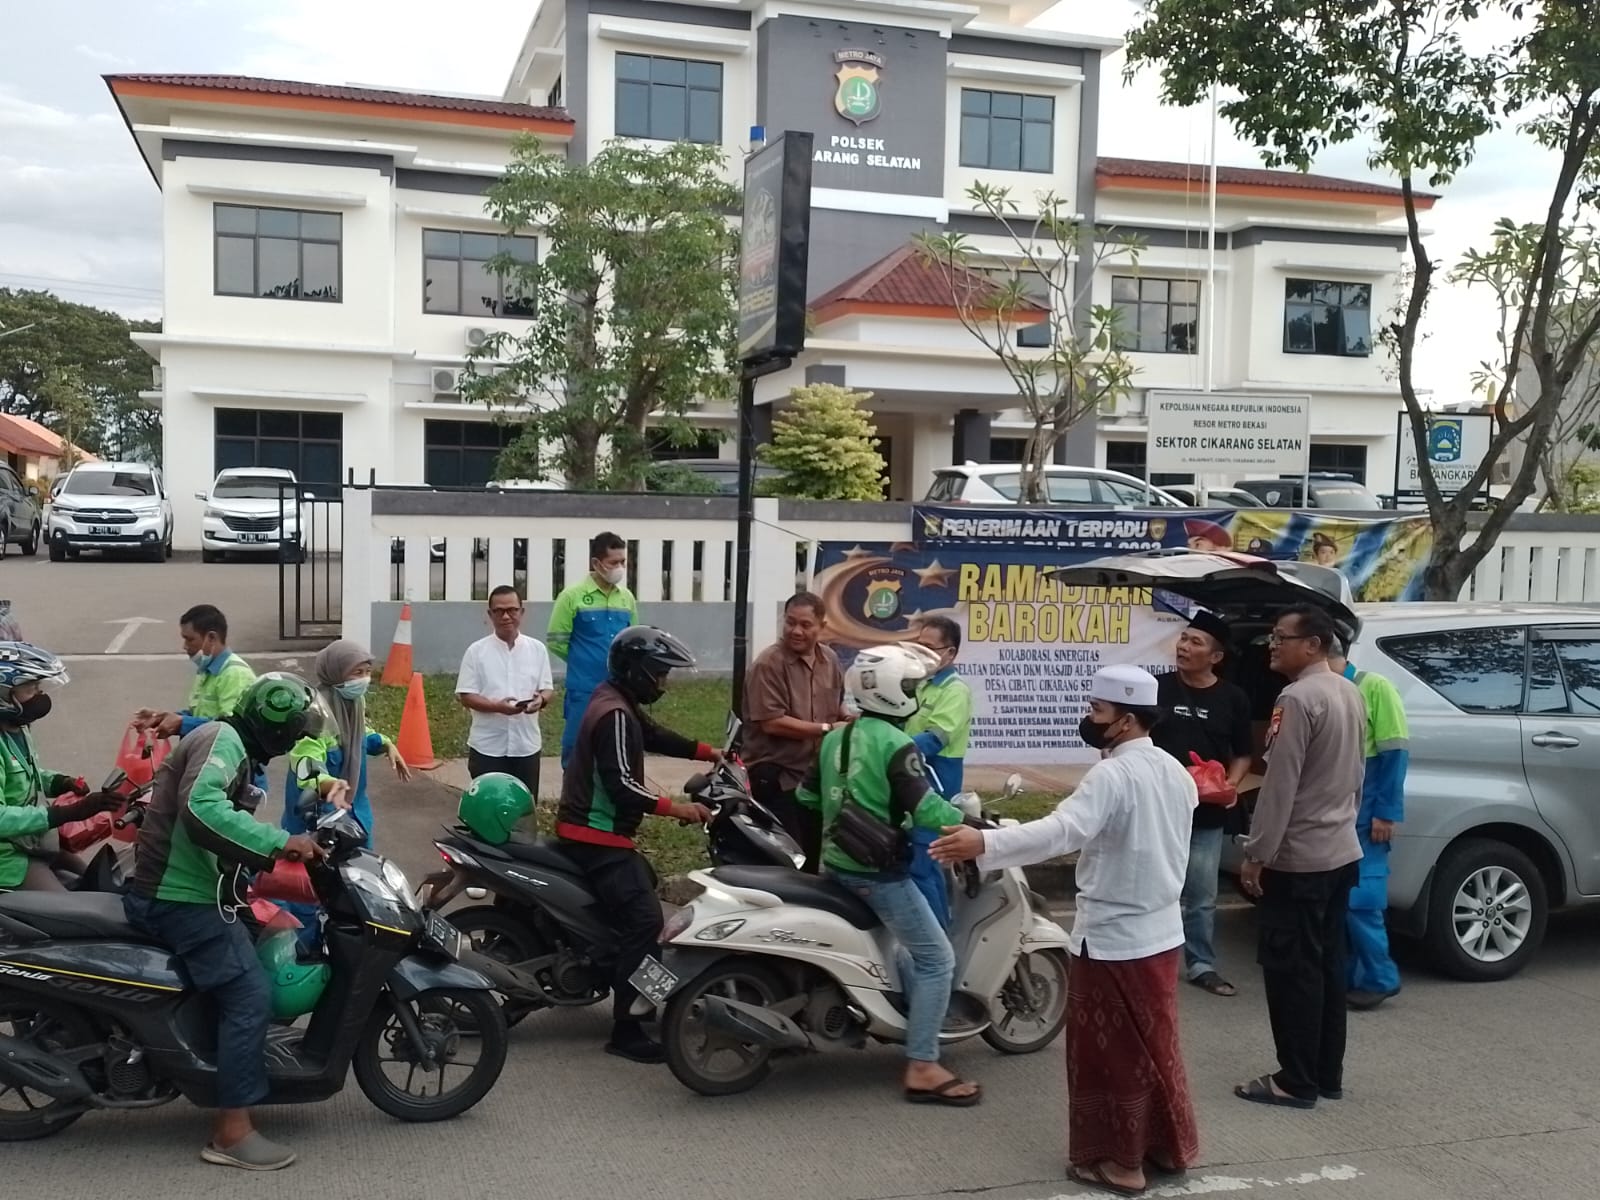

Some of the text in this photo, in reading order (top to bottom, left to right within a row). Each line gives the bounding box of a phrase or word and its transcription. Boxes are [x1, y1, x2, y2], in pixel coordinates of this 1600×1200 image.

[831, 135, 885, 150] POLSEK
[813, 150, 921, 169] ARANG SELATAN
[1159, 402, 1302, 414] KEPOLISIAN NEGARA REPUBLIK INDONESIA
[1193, 420, 1268, 430] RESOR METRO BEKASI
[1155, 436, 1302, 451] SEKTOR CIKARANG SELATAN
[942, 518, 1149, 539] PENERIMAAN TERPADU
[968, 603, 1132, 644] BAROKAH
[1053, 649, 1101, 662] SINERGITAS
[954, 663, 988, 676] ELATAN
[989, 663, 1022, 676] DENGAN
[1023, 664, 1042, 676] DKM
[1043, 664, 1073, 677] MASJID
[985, 678, 1007, 691] DESA
[1008, 679, 1037, 692] CIBATU
[1039, 679, 1079, 692] CIKARANG
[968, 728, 1004, 737] EMBERIAN
